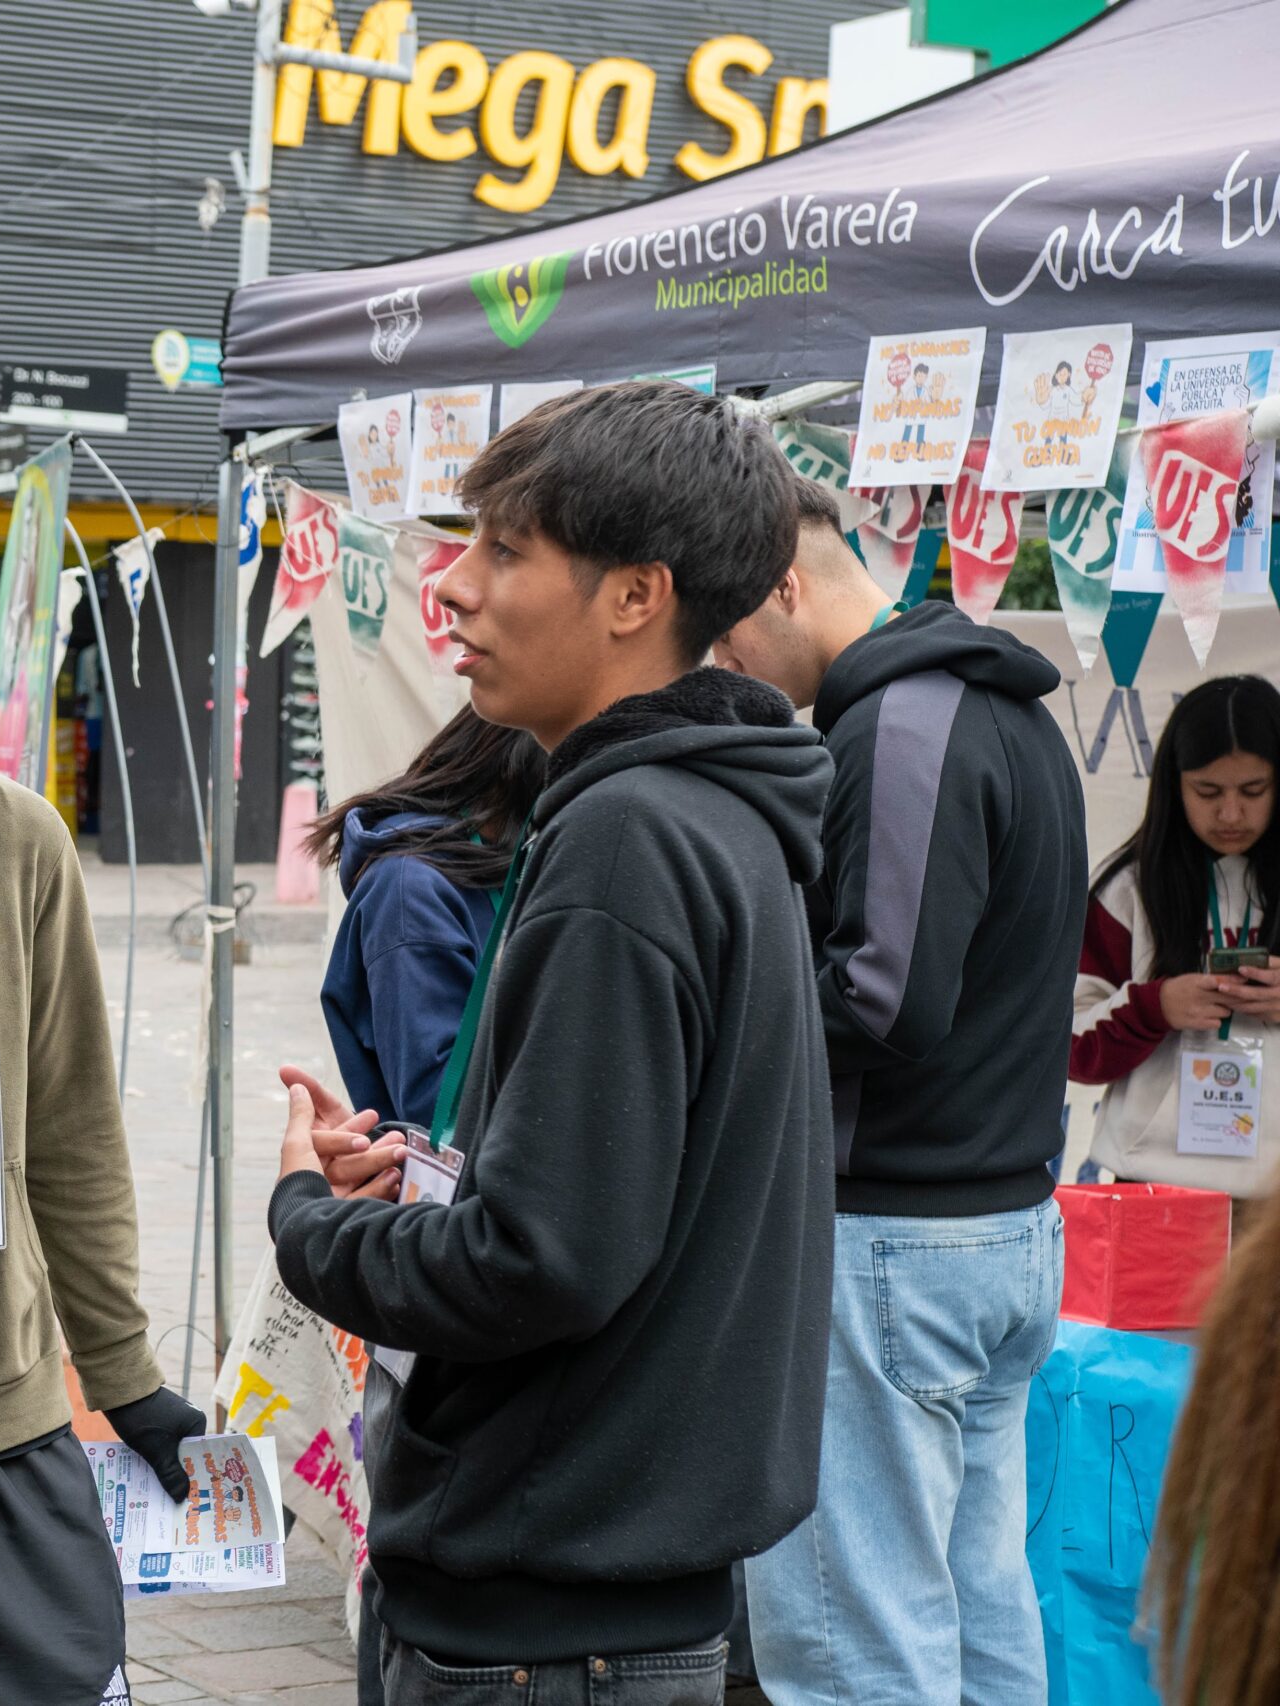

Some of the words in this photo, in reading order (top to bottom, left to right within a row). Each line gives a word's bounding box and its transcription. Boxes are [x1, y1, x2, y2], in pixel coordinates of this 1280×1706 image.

[272, 0, 657, 213] Mega
[583, 207, 768, 281] Florencio
[780, 187, 919, 250] Varela
[655, 256, 828, 312] Municipalidad
[1170, 381, 1181, 393] LA
[1183, 375, 1243, 391] UNIVERSIDAD
[1174, 369, 1186, 382] EN
[1187, 365, 1228, 380] DEFENSA
[1229, 363, 1242, 374] DE
[1219, 386, 1226, 398] Y
[1013, 420, 1036, 443] TU
[1023, 443, 1081, 468] CUENTA
[951, 474, 1020, 562] UES
[1156, 459, 1237, 558] UES
[1048, 488, 1123, 573] UES
[343, 552, 388, 617] UES
[1203, 1089, 1244, 1102] U.E.S
[117, 1489, 125, 1512] SUMATE
[115, 1527, 123, 1538] UES
[116, 1518, 123, 1526] LA
[265, 1543, 274, 1574] VIOLENCIA
